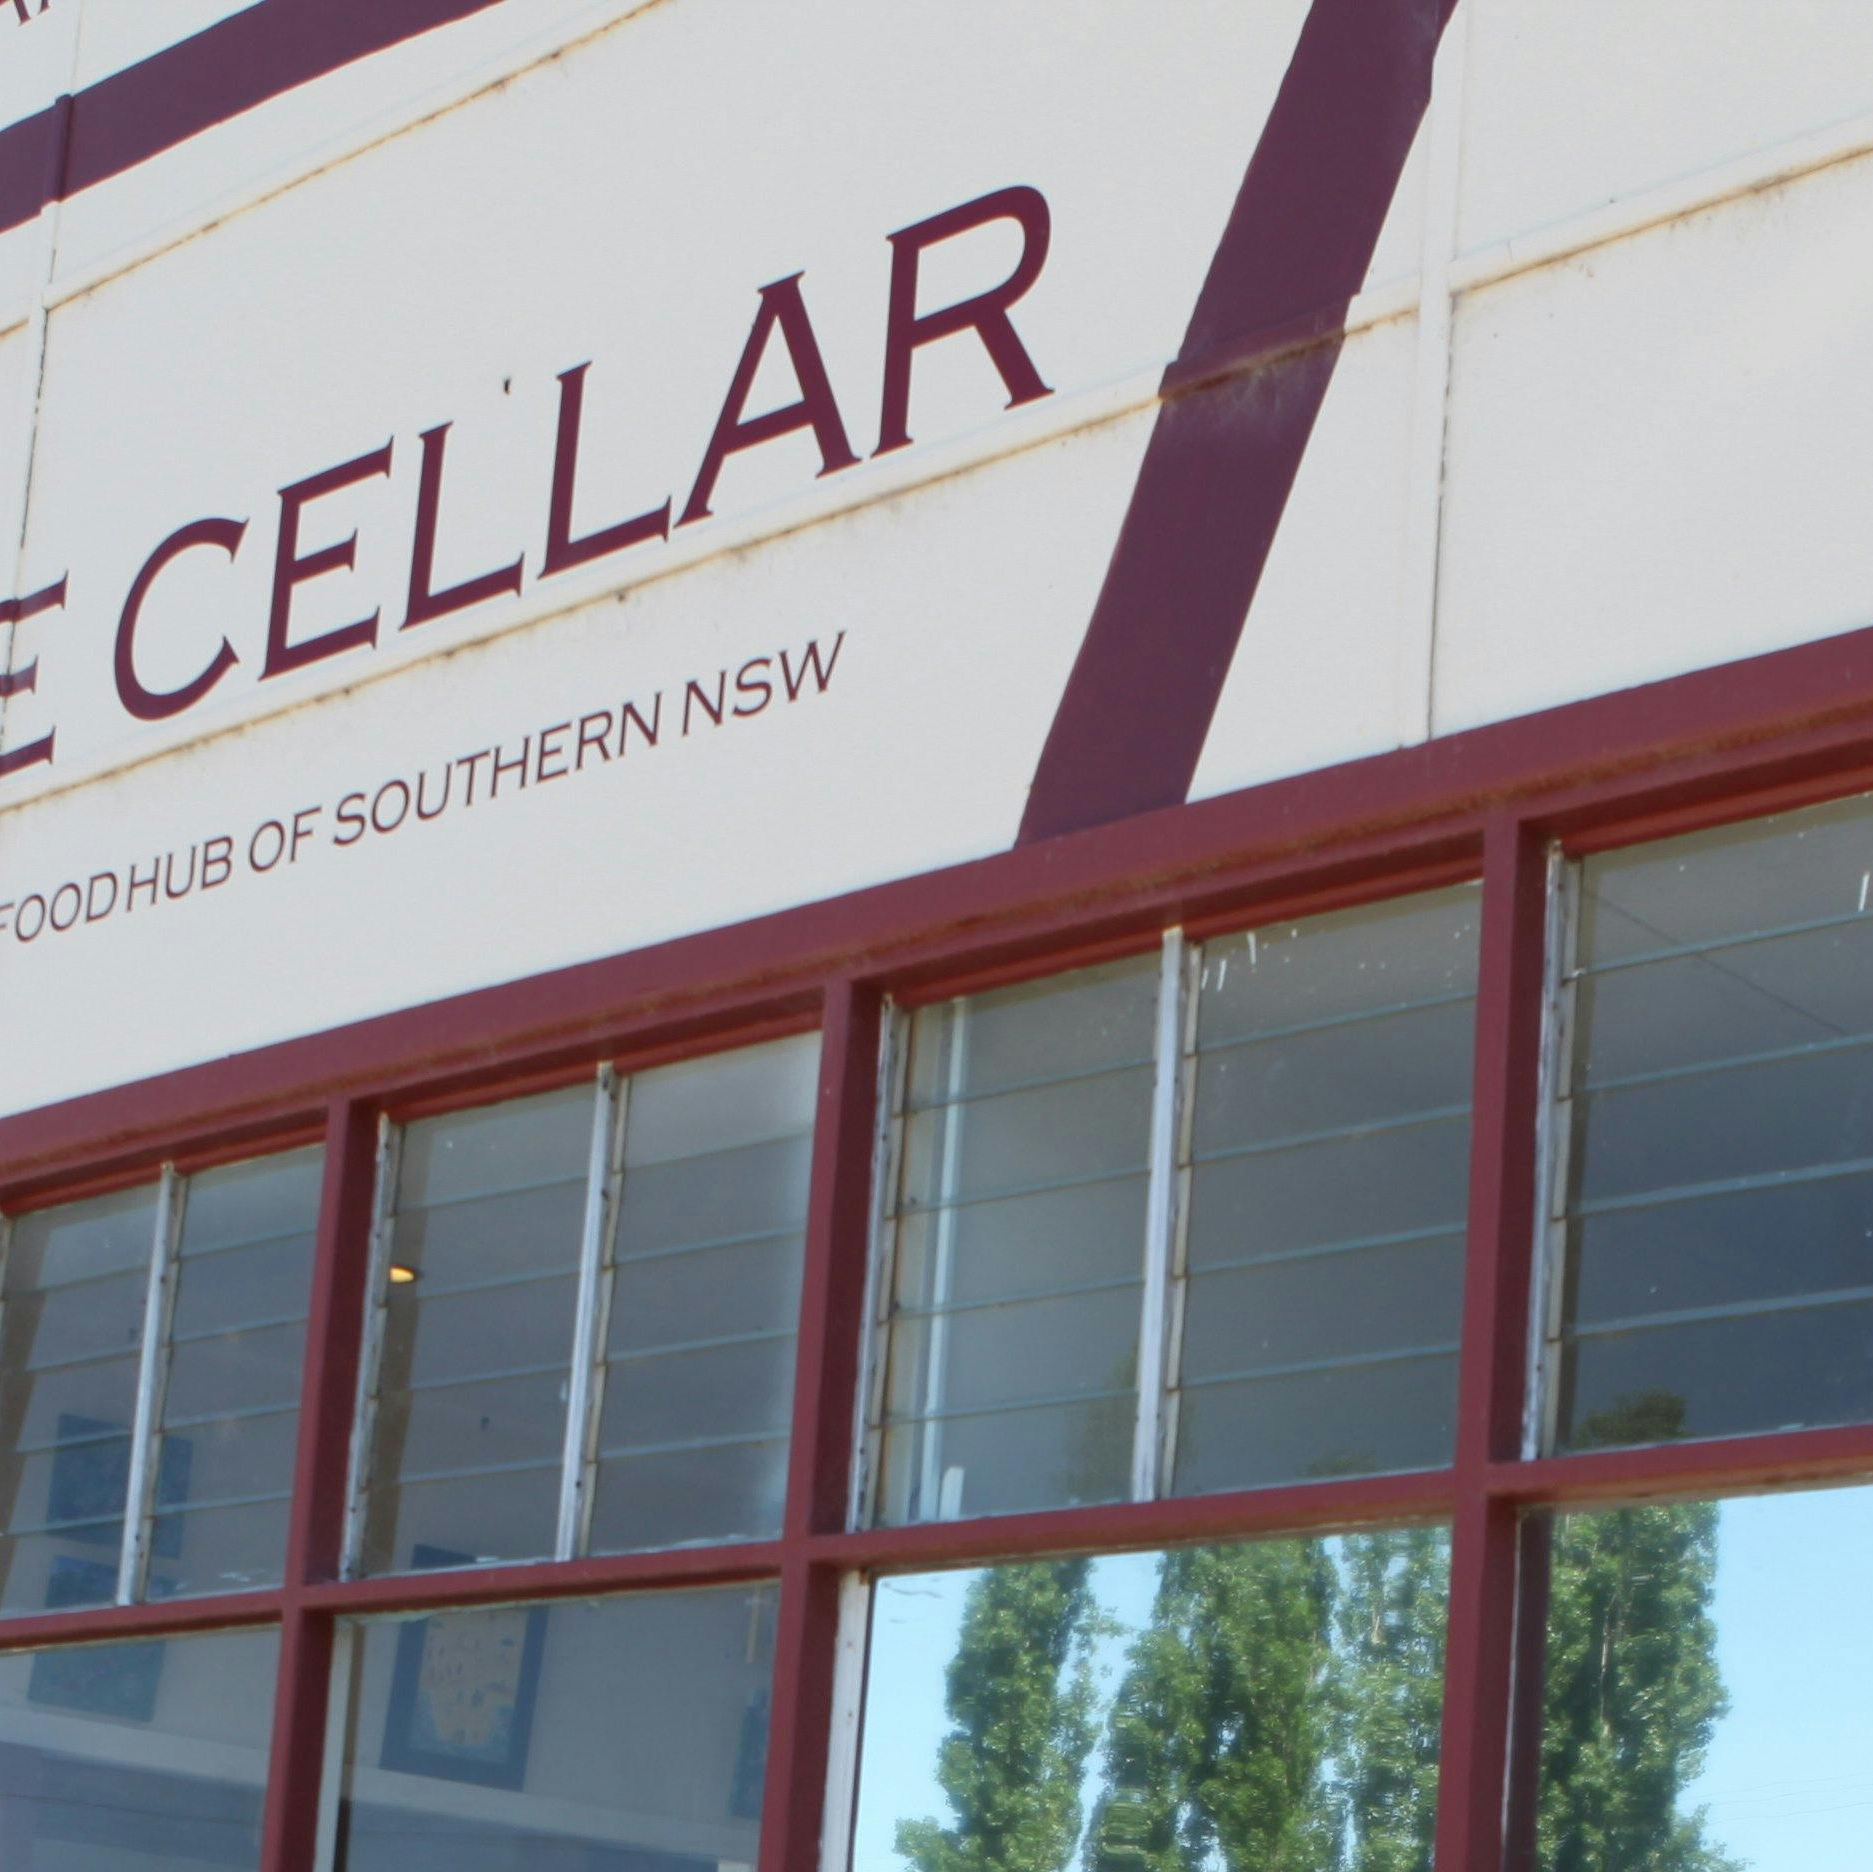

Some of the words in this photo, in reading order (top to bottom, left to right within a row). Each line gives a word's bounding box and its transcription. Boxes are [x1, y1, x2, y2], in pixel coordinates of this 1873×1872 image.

[113, 183, 1056, 722] CELLAR
[249, 806, 322, 873] OF
[331, 691, 662, 849] SOUTHERN
[680, 630, 847, 738] NSW
